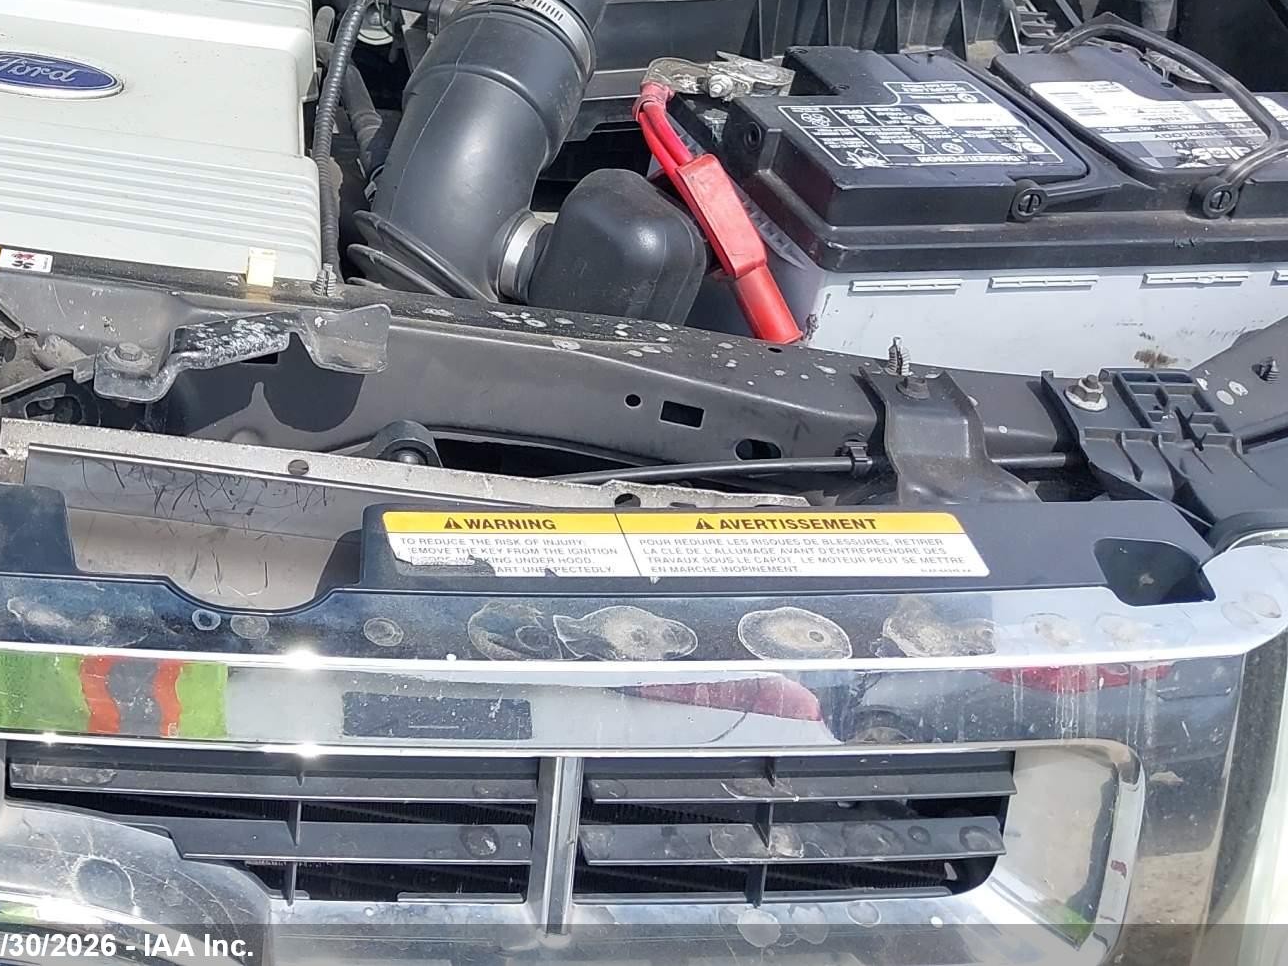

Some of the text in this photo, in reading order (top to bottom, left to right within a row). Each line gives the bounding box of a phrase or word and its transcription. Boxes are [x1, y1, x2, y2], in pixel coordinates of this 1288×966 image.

[463, 518, 557, 531] WARNING
[719, 518, 877, 531] AVERTISSEMENT
[400, 537, 415, 545] TO
[419, 537, 466, 545] REDUCE
[469, 537, 491, 545] THE
[494, 537, 520, 545] RISK
[524, 537, 538, 545] OF
[639, 538, 671, 546] POUR
[726, 538, 748, 546] LES
[750, 538, 800, 546] RISQUES
[803, 538, 819, 546] DE
[894, 538, 944, 546] RETIRER
[567, 547, 617, 555] IGNITION
[642, 547, 657, 555] LA
[685, 547, 700, 555] DE
[780, 547, 814, 555] AVANT
[923, 547, 947, 555] DES
[648, 556, 699, 564] TRAVAUX
[702, 556, 734, 564] SOUS
[736, 556, 751, 564] LE
[800, 556, 814, 564] LE
[817, 556, 865, 564] MOTEUR
[869, 556, 898, 564] PEUT
[901, 556, 917, 564] SE
[919, 556, 965, 564] METTRE
[522, 566, 614, 574] UNEPECTEDLY.
[651, 565, 666, 573] EN
[669, 565, 719, 573] MARCHE
